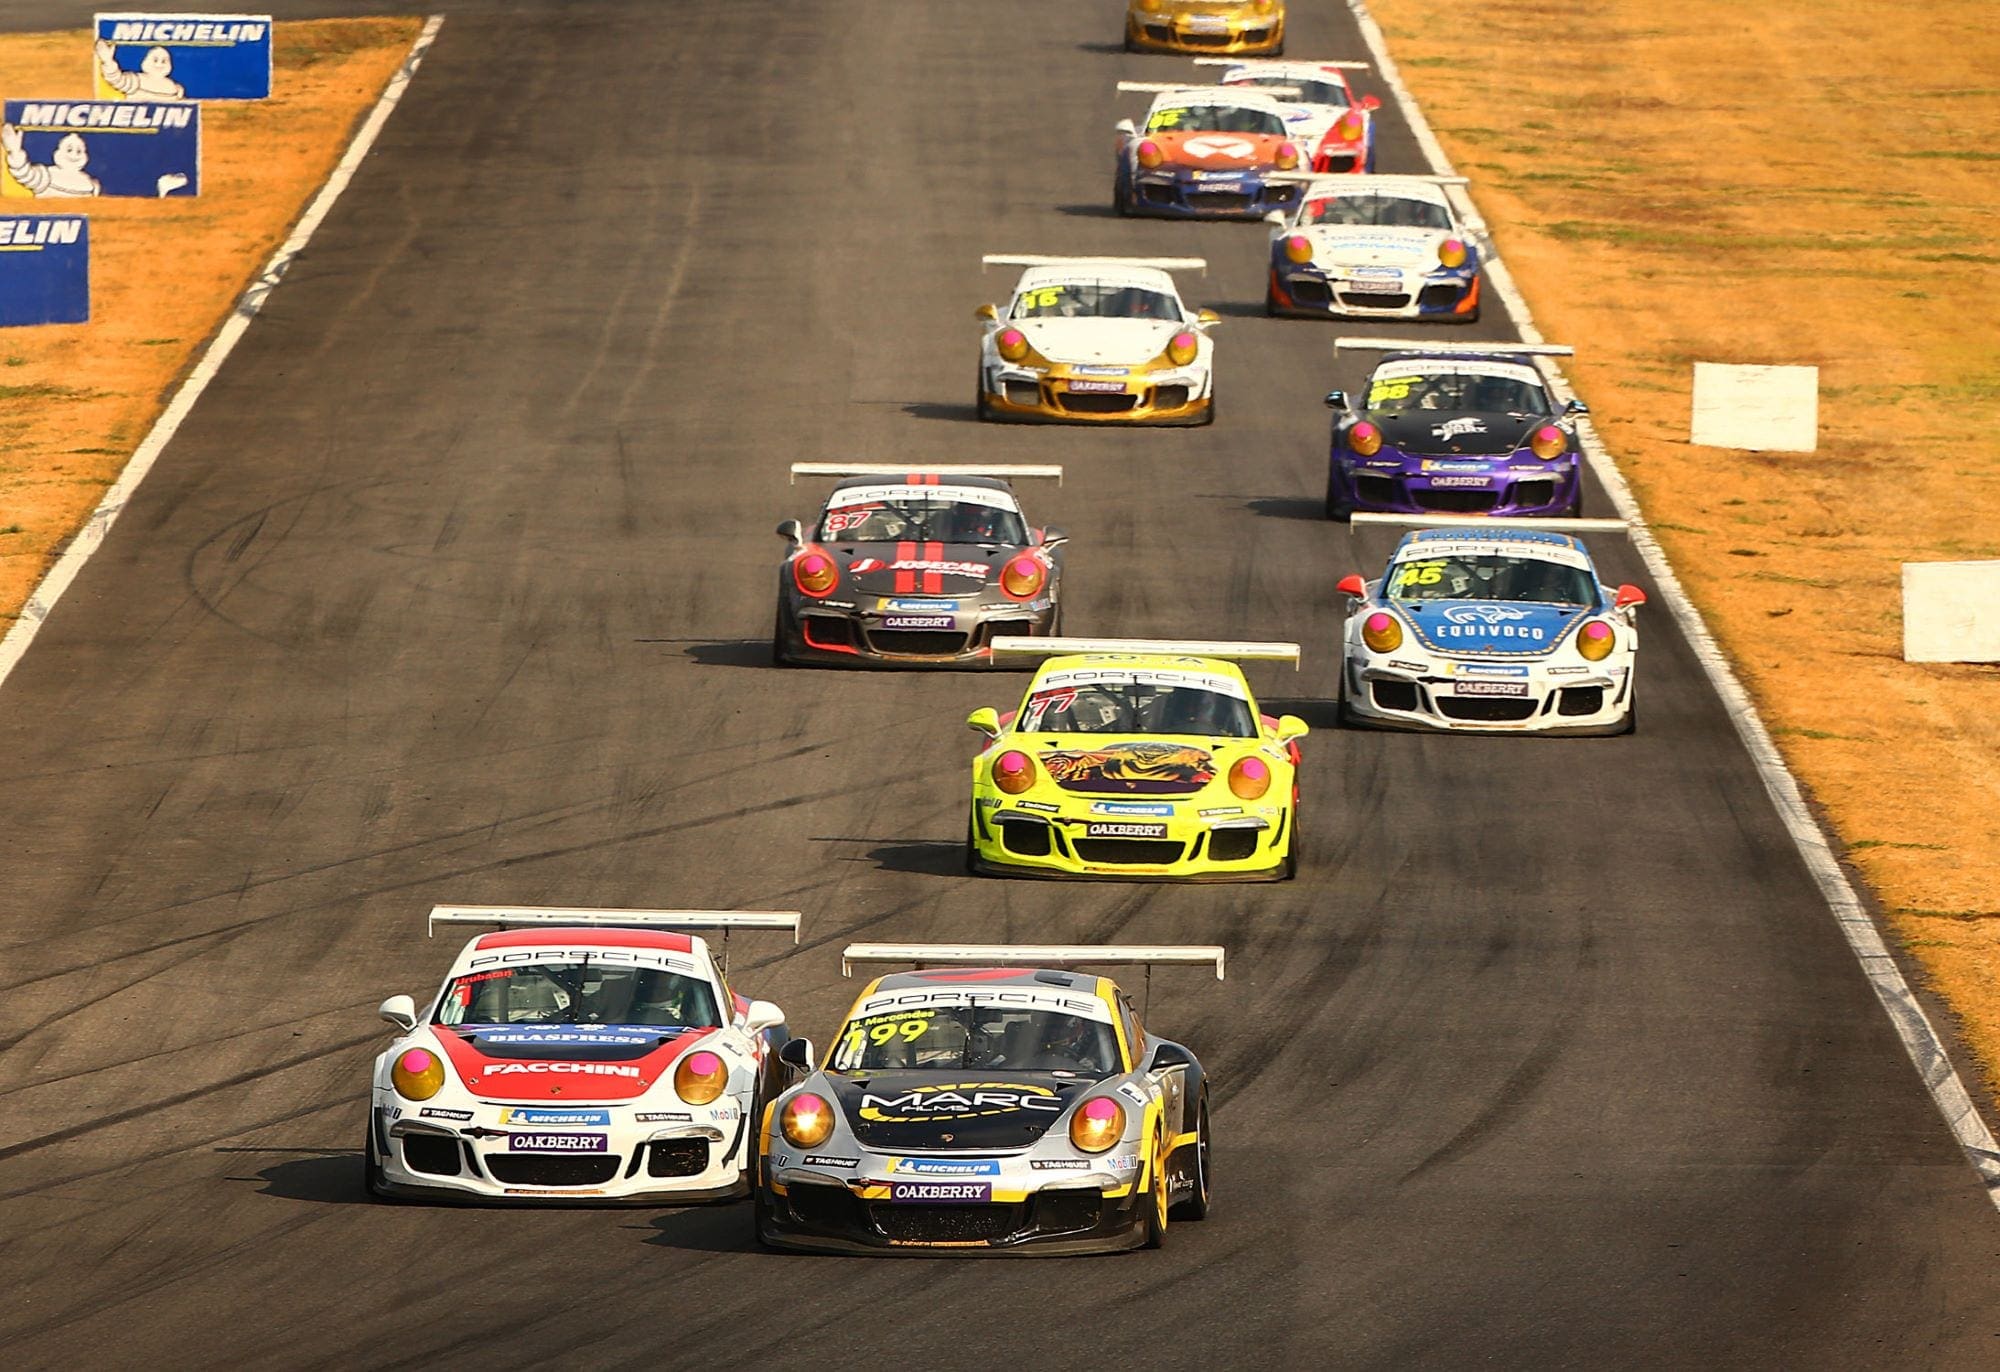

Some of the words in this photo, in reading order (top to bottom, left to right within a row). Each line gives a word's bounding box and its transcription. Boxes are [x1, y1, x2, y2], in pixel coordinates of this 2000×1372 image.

[112, 22, 266, 42] MICHELIN
[20, 103, 192, 129] MICHELIN
[842, 488, 1002, 502] PORSCHE
[826, 511, 872, 533] 87
[1406, 545, 1579, 562] PORSCHE
[889, 559, 990, 574] JOSECAR
[1395, 567, 1442, 587] 45
[886, 617, 951, 627] OAKBERRY
[1436, 625, 1545, 640] EQUIVOCO
[1046, 671, 1234, 691] PORSCHE
[1456, 683, 1525, 694] OAKBERRY
[1029, 692, 1078, 717] 77
[1089, 824, 1165, 836] OAKBERRY
[470, 950, 694, 971] PORSCHE
[455, 969, 513, 985] Urubatan
[452, 985, 472, 1007] 1
[865, 993, 1095, 1013] PORSCHE
[865, 1010, 936, 1026] Marcondes
[487, 1033, 646, 1044] BRASPRESS
[843, 1020, 929, 1052] 199
[483, 1062, 640, 1077] FACCHINI
[861, 1092, 1062, 1110] MARC
[530, 1114, 602, 1123] MICHELIN
[513, 1136, 603, 1149] OAKBERRY
[917, 1164, 991, 1173] MICHELIN
[895, 1185, 987, 1199] OAKBERRY
